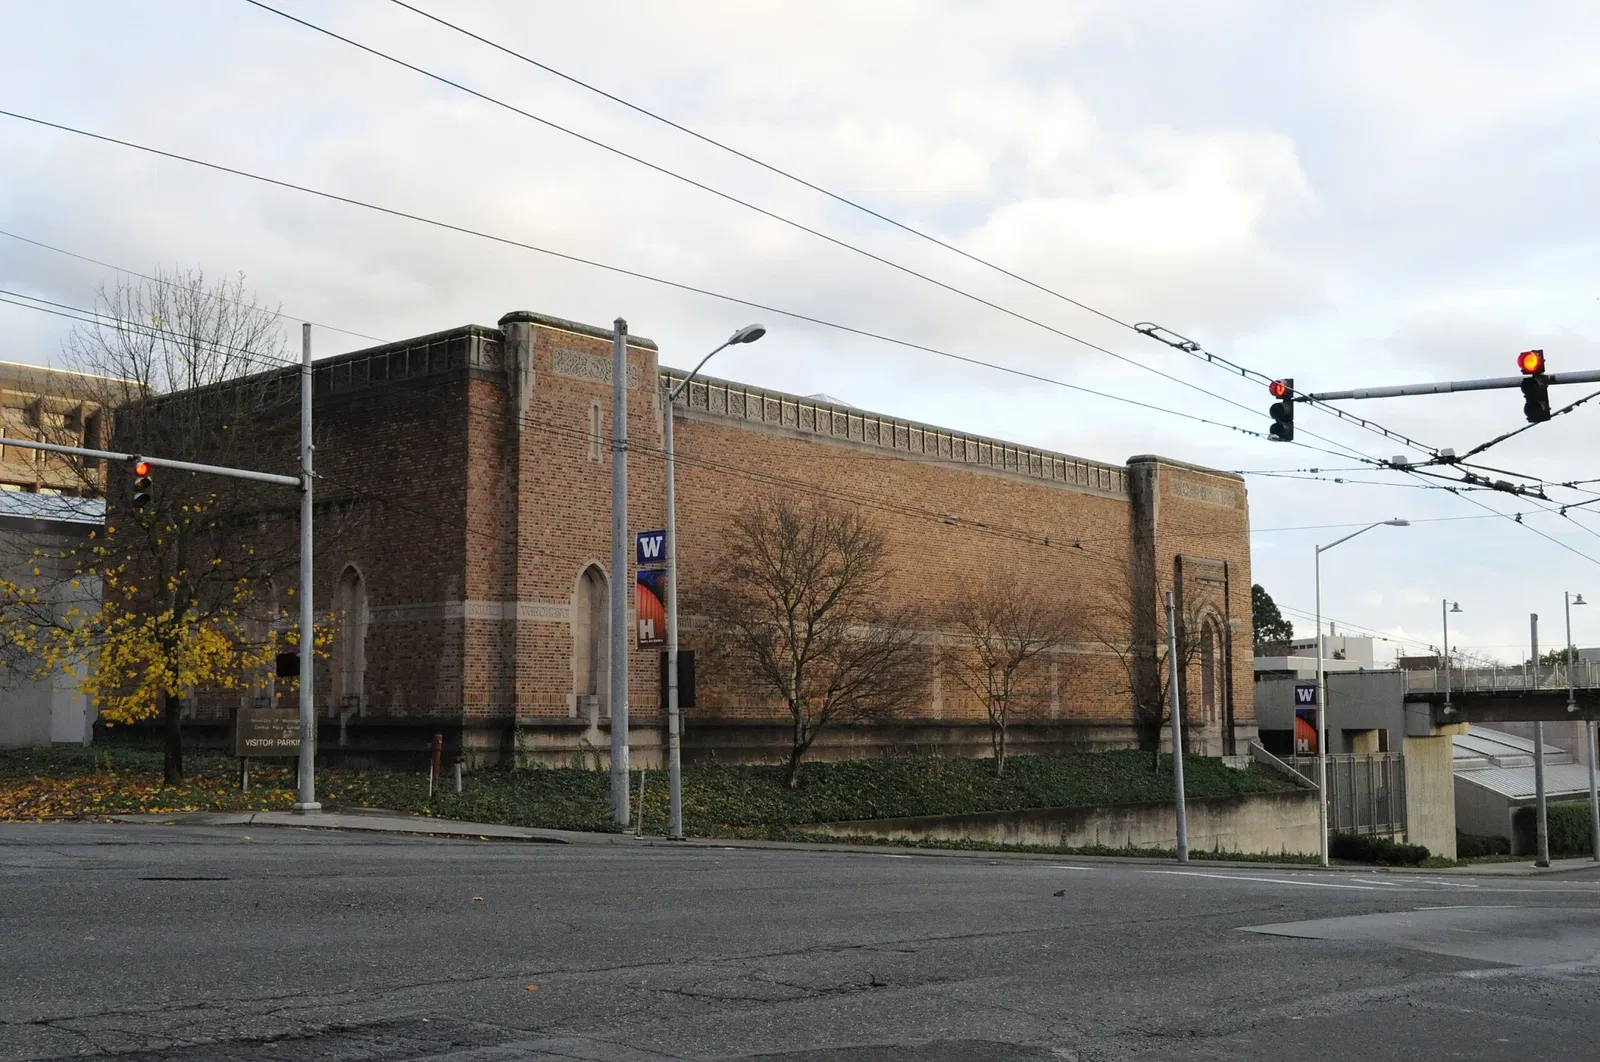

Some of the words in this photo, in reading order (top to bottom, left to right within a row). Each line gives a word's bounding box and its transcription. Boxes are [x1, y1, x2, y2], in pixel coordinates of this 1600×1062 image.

[640, 535, 663, 558] W
[639, 618, 655, 639] H
[1297, 688, 1314, 702] W
[245, 738, 273, 747] VISITOR
[1297, 738, 1308, 752] H
